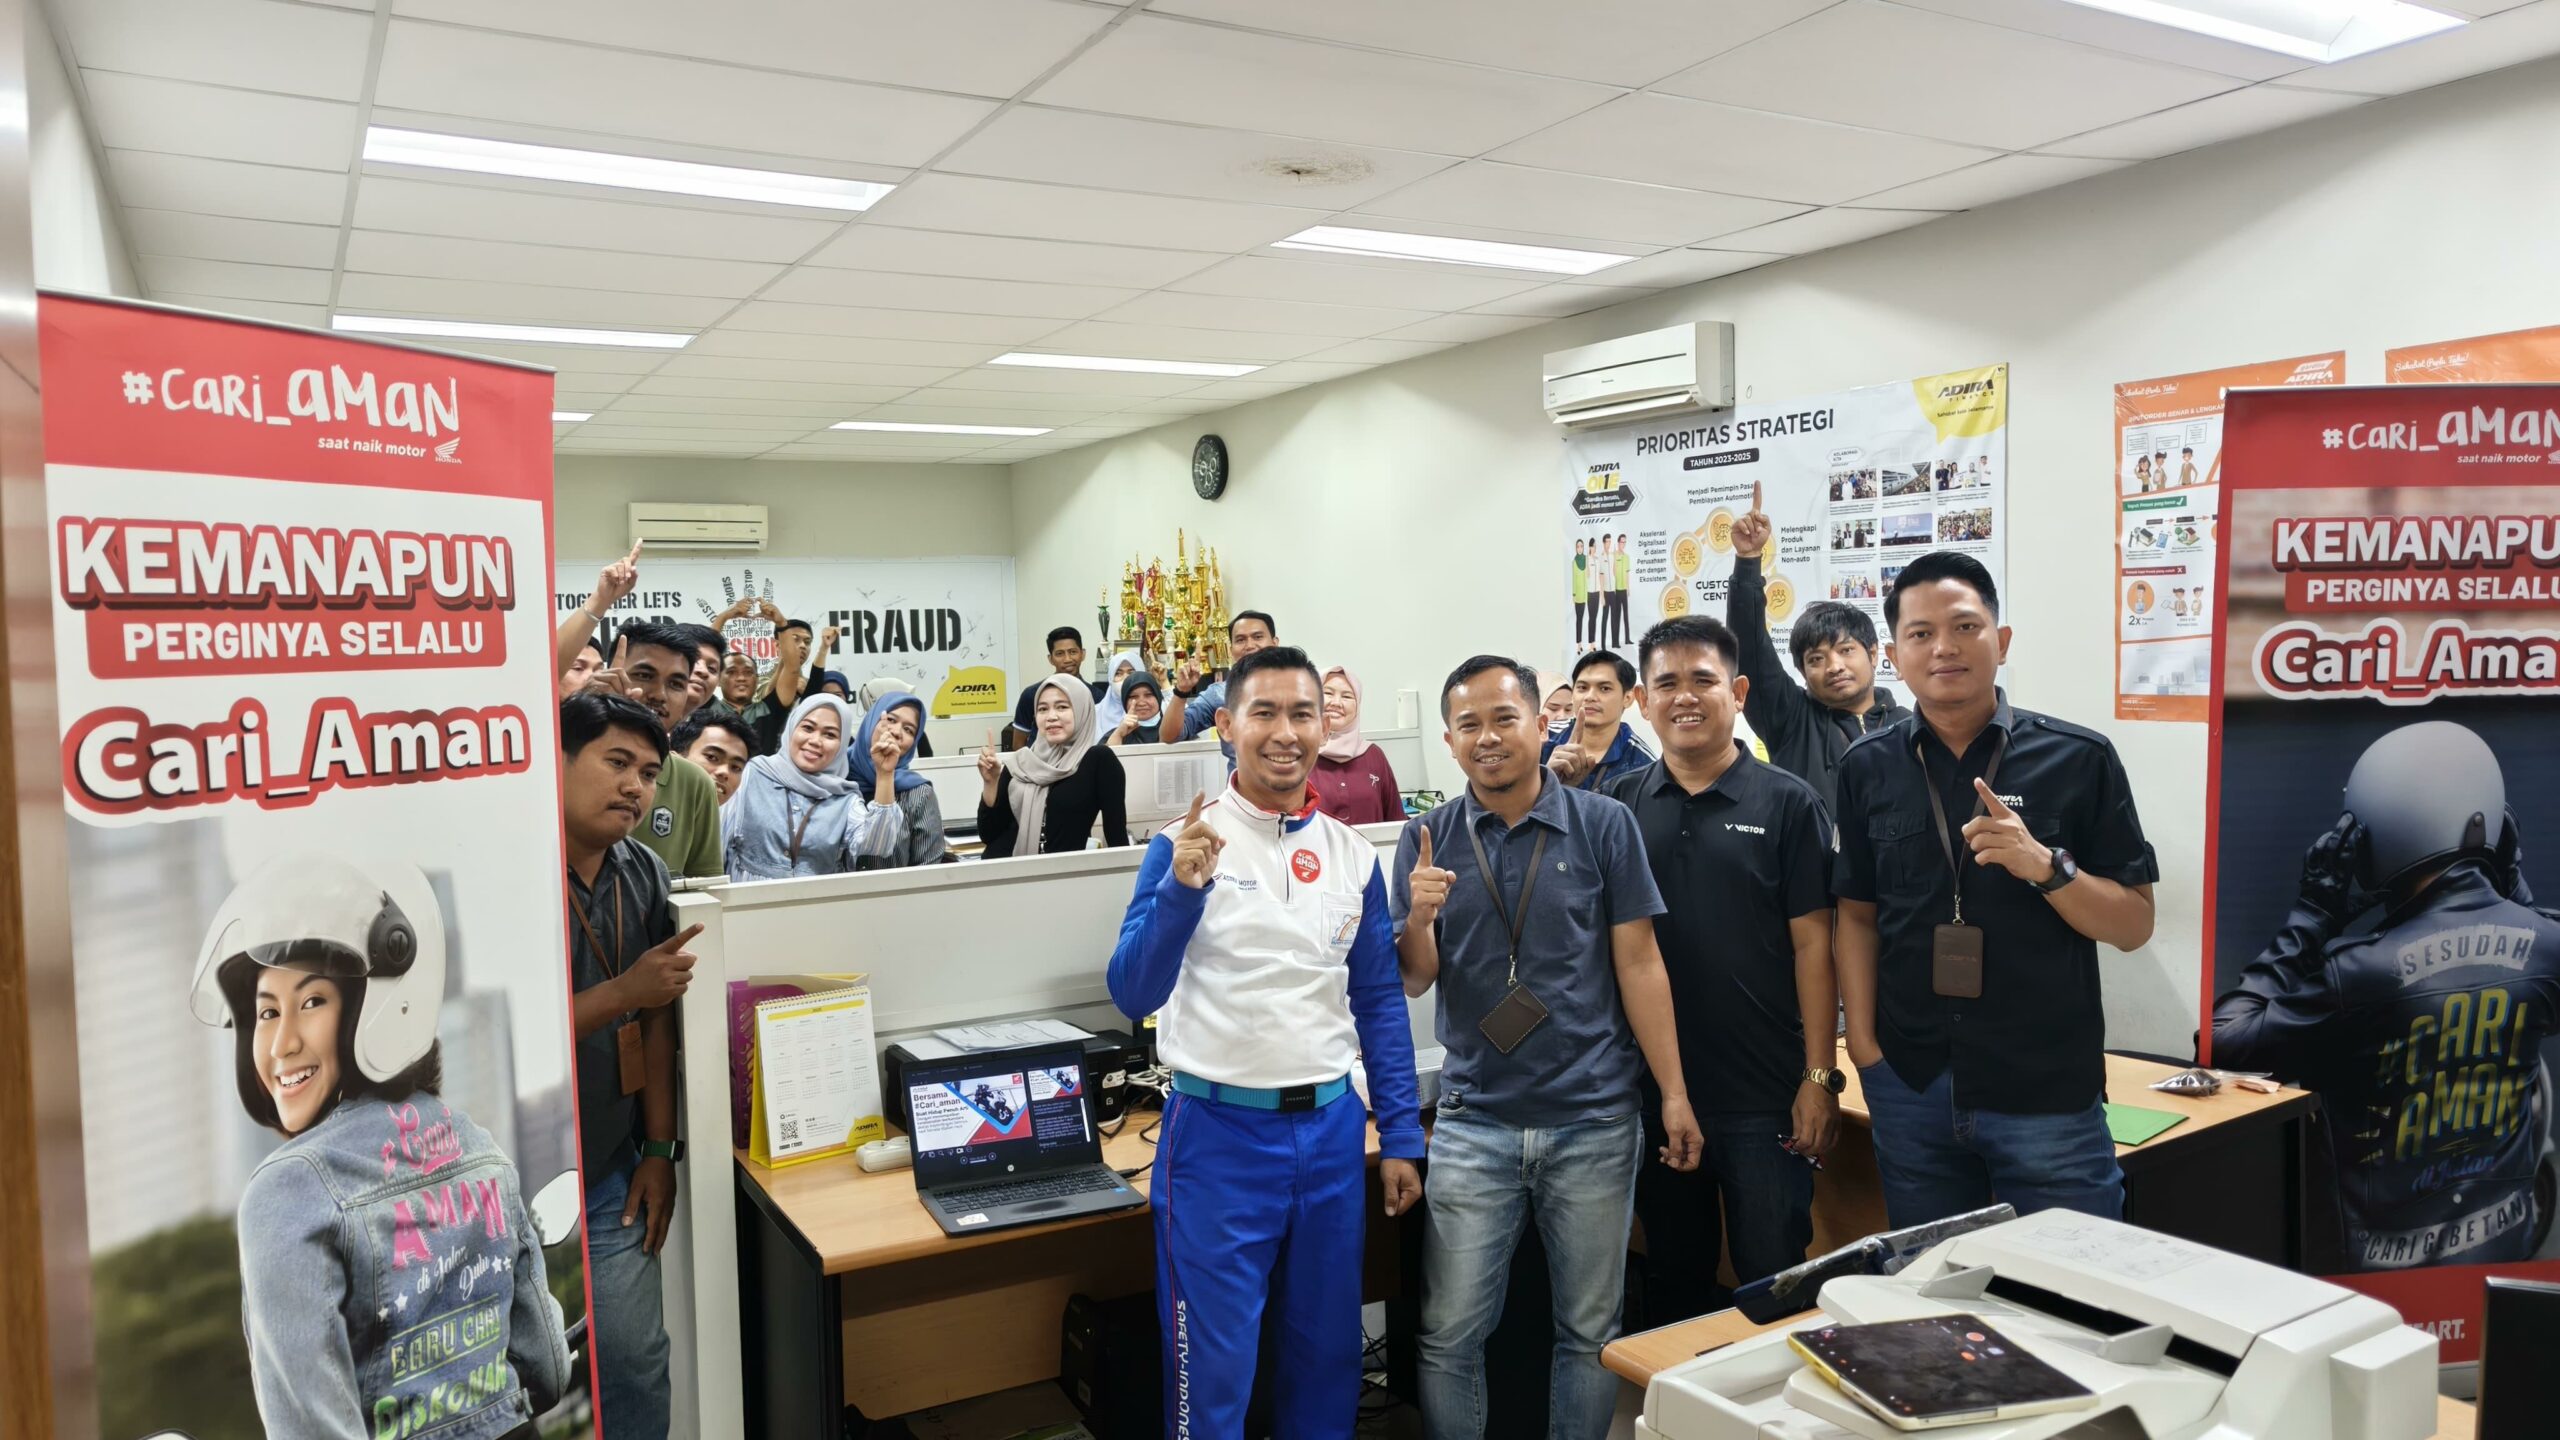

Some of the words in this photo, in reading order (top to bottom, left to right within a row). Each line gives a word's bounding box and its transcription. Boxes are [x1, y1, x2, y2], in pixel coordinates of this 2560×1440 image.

[1938, 378, 1994, 398] ADIRA
[1636, 424, 1730, 456] PRIORITAS
[1736, 408, 1834, 441] STRATEGI
[318, 437, 349, 450] saat
[353, 439, 382, 453] naik
[386, 444, 426, 458] motor
[435, 456, 462, 465] HONDA
[1690, 457, 1714, 468] TAHUN
[1714, 451, 1751, 465] 2023-2025
[2457, 453, 2479, 463] saat
[2481, 452, 2503, 463] naik
[2505, 453, 2542, 463] motor
[1588, 461, 1620, 474] ADIRA
[1687, 486, 1709, 497] Menjadi
[1710, 483, 1739, 495] Pemimpin
[1740, 482, 1754, 491] Pasa
[1689, 495, 1724, 506] Pembiayaan
[1725, 491, 1754, 501] Automoti
[1780, 524, 1817, 535] Melengkapi
[1638, 538, 1667, 548] Digitalisasi
[1794, 545, 1821, 555] Layanan
[63, 524, 509, 598] KEMANAPUN
[1636, 557, 1667, 565] Perusahaan
[1781, 556, 1811, 564] Non-auto
[1639, 575, 1667, 583] Ekosistem
[1647, 566, 1667, 575] dengan
[2307, 577, 2451, 603] PERGINYA
[643, 591, 682, 609] LETS
[702, 604, 718, 624] STO
[829, 608, 962, 655] FRAUD
[122, 620, 329, 662] PERGINYA
[340, 621, 484, 656] SELALU
[952, 684, 996, 693] ADIRA
[77, 709, 525, 800] Cari_Aman
[1735, 824, 1765, 835] VICTOR
[1238, 879, 1257, 887] MOTOR
[2403, 934, 2531, 976] SESUDAH
[913, 1090, 948, 1102] Bersama
[915, 1098, 961, 1110] #Cari_aman
[2394, 1062, 2527, 1160] AMAN
[392, 1178, 508, 1272] AMAN
[2367, 1233, 2417, 1261] CARI
[417, 1267, 431, 1294] di
[391, 1318, 457, 1378] BARU
[374, 1348, 508, 1440] DISKONAN
